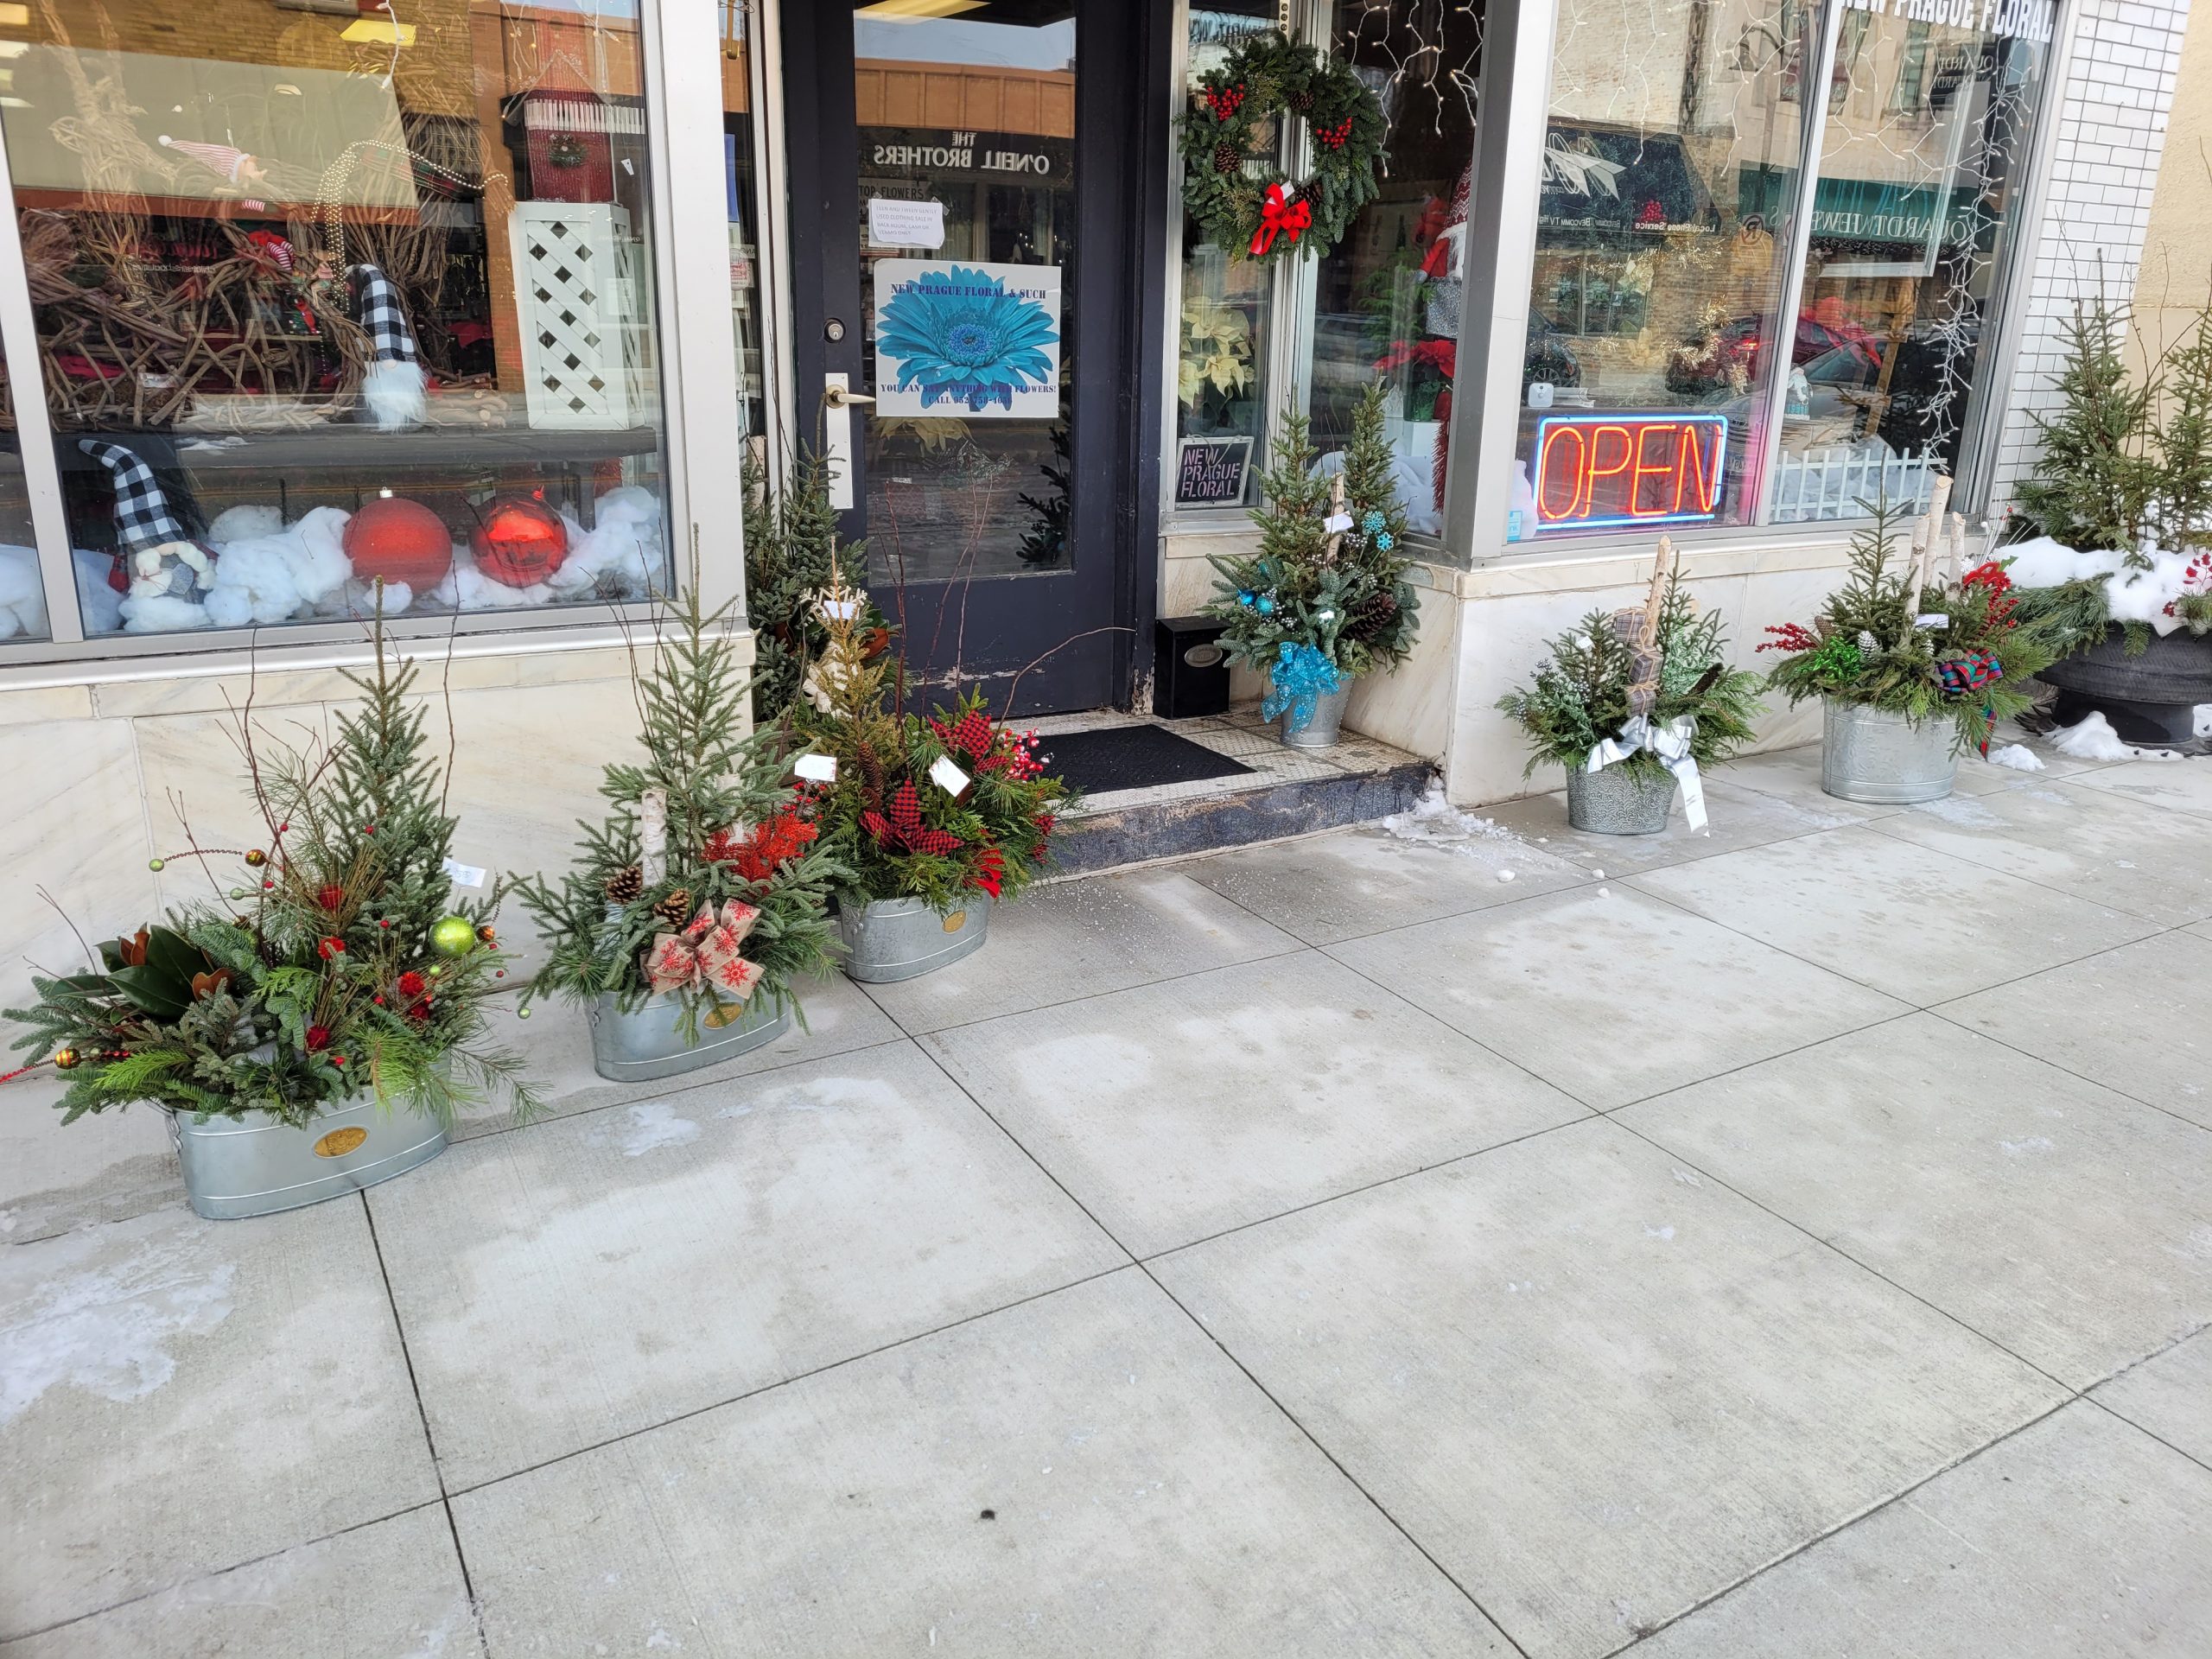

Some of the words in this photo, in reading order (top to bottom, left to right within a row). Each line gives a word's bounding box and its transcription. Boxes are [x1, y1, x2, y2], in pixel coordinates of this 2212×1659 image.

[1980, 0, 2053, 42] FLORAL
[880, 186, 925, 200] FLOWERS
[891, 283, 914, 294] NEW
[918, 284, 962, 296] PRAGUE
[964, 286, 1005, 298] FLORAL
[1008, 288, 1016, 298] &
[1020, 289, 1046, 299] SUCH
[880, 384, 899, 392] YOU
[902, 384, 920, 392] CAN
[1014, 385, 1057, 393] FLOWERS!
[929, 396, 950, 404] CALL
[1184, 448, 1219, 466] NEW
[1183, 462, 1241, 482] PRAGUE
[1539, 423, 1723, 519] OPEN
[1180, 480, 1235, 498] FLORAL
